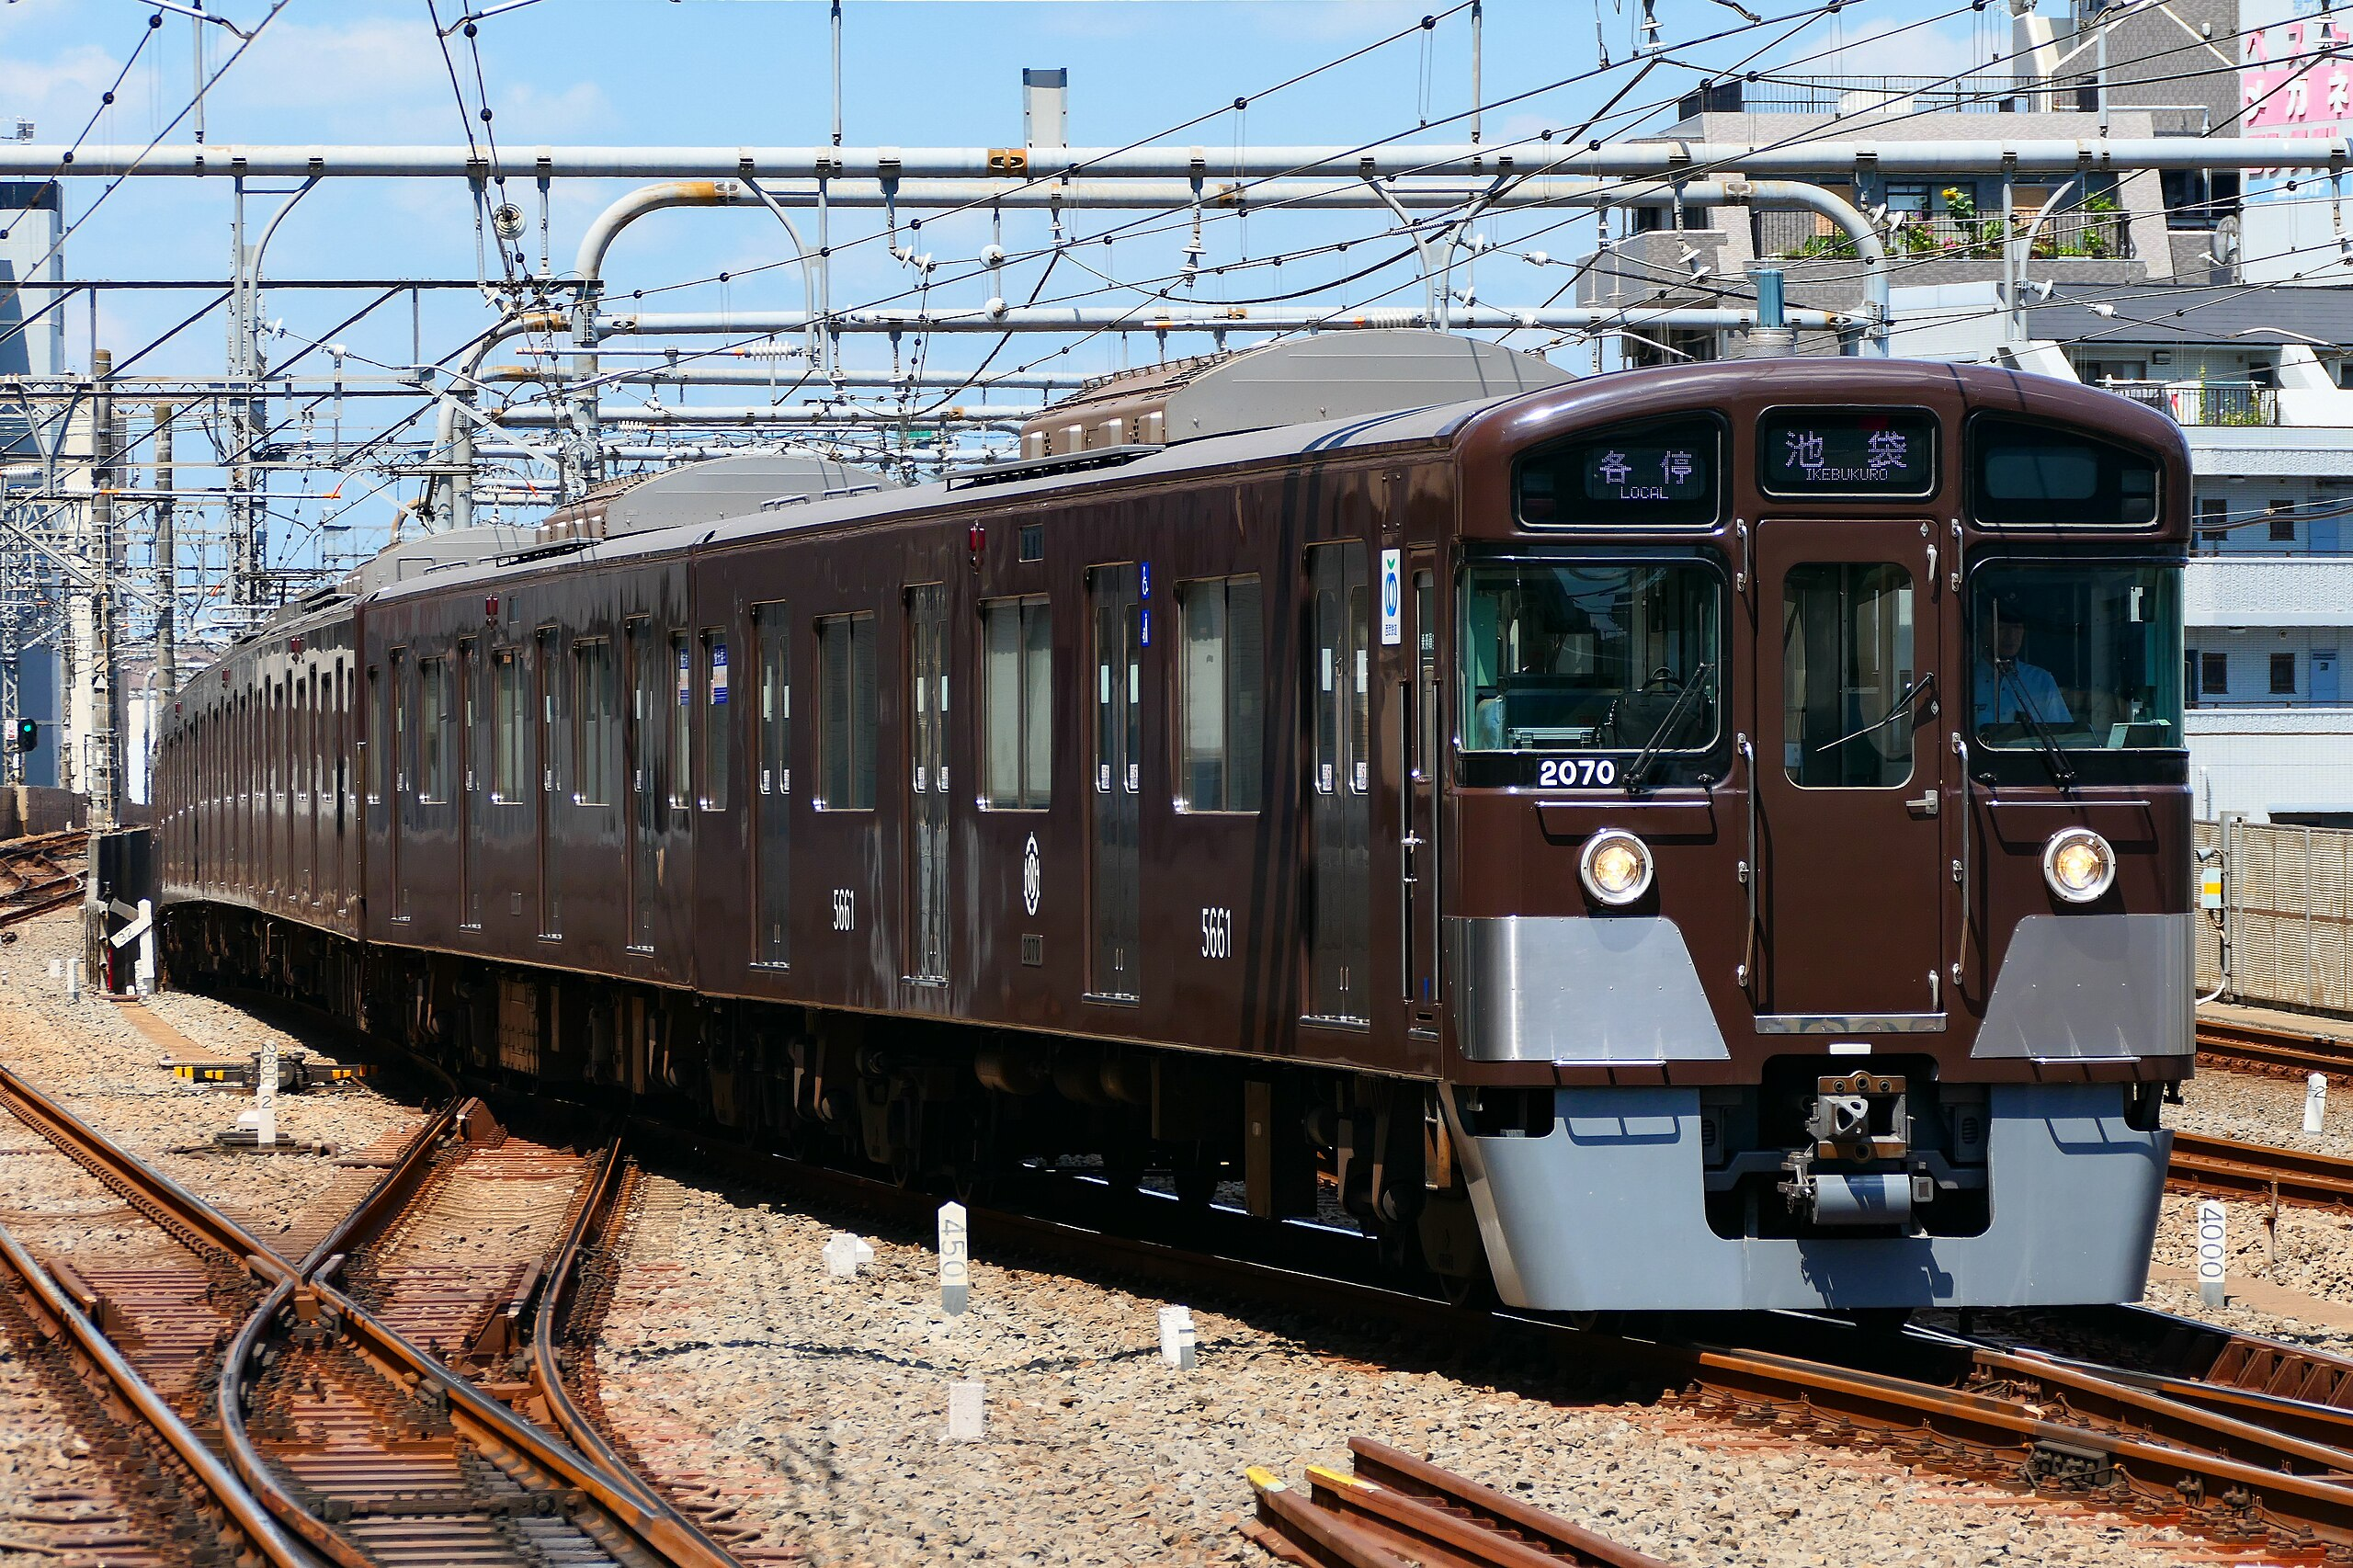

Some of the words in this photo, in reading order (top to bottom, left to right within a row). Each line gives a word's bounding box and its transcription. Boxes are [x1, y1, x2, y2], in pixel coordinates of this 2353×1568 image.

[2245, 70, 2350, 122] メガネ
[1599, 449, 1692, 484] 各停
[1785, 430, 1907, 468] 池袋
[1620, 486, 1669, 499] LOCAL
[1805, 468, 1889, 481] IKEBUKURO
[1540, 760, 1615, 786] 2070
[833, 888, 855, 931] 5661
[118, 927, 135, 943] 32
[1023, 937, 1040, 961] 2070
[1201, 907, 1231, 959] 5661
[261, 1043, 278, 1087] 2600
[261, 1095, 273, 1109] 2
[941, 1219, 966, 1278] 450
[2200, 1207, 2224, 1278] 4000
